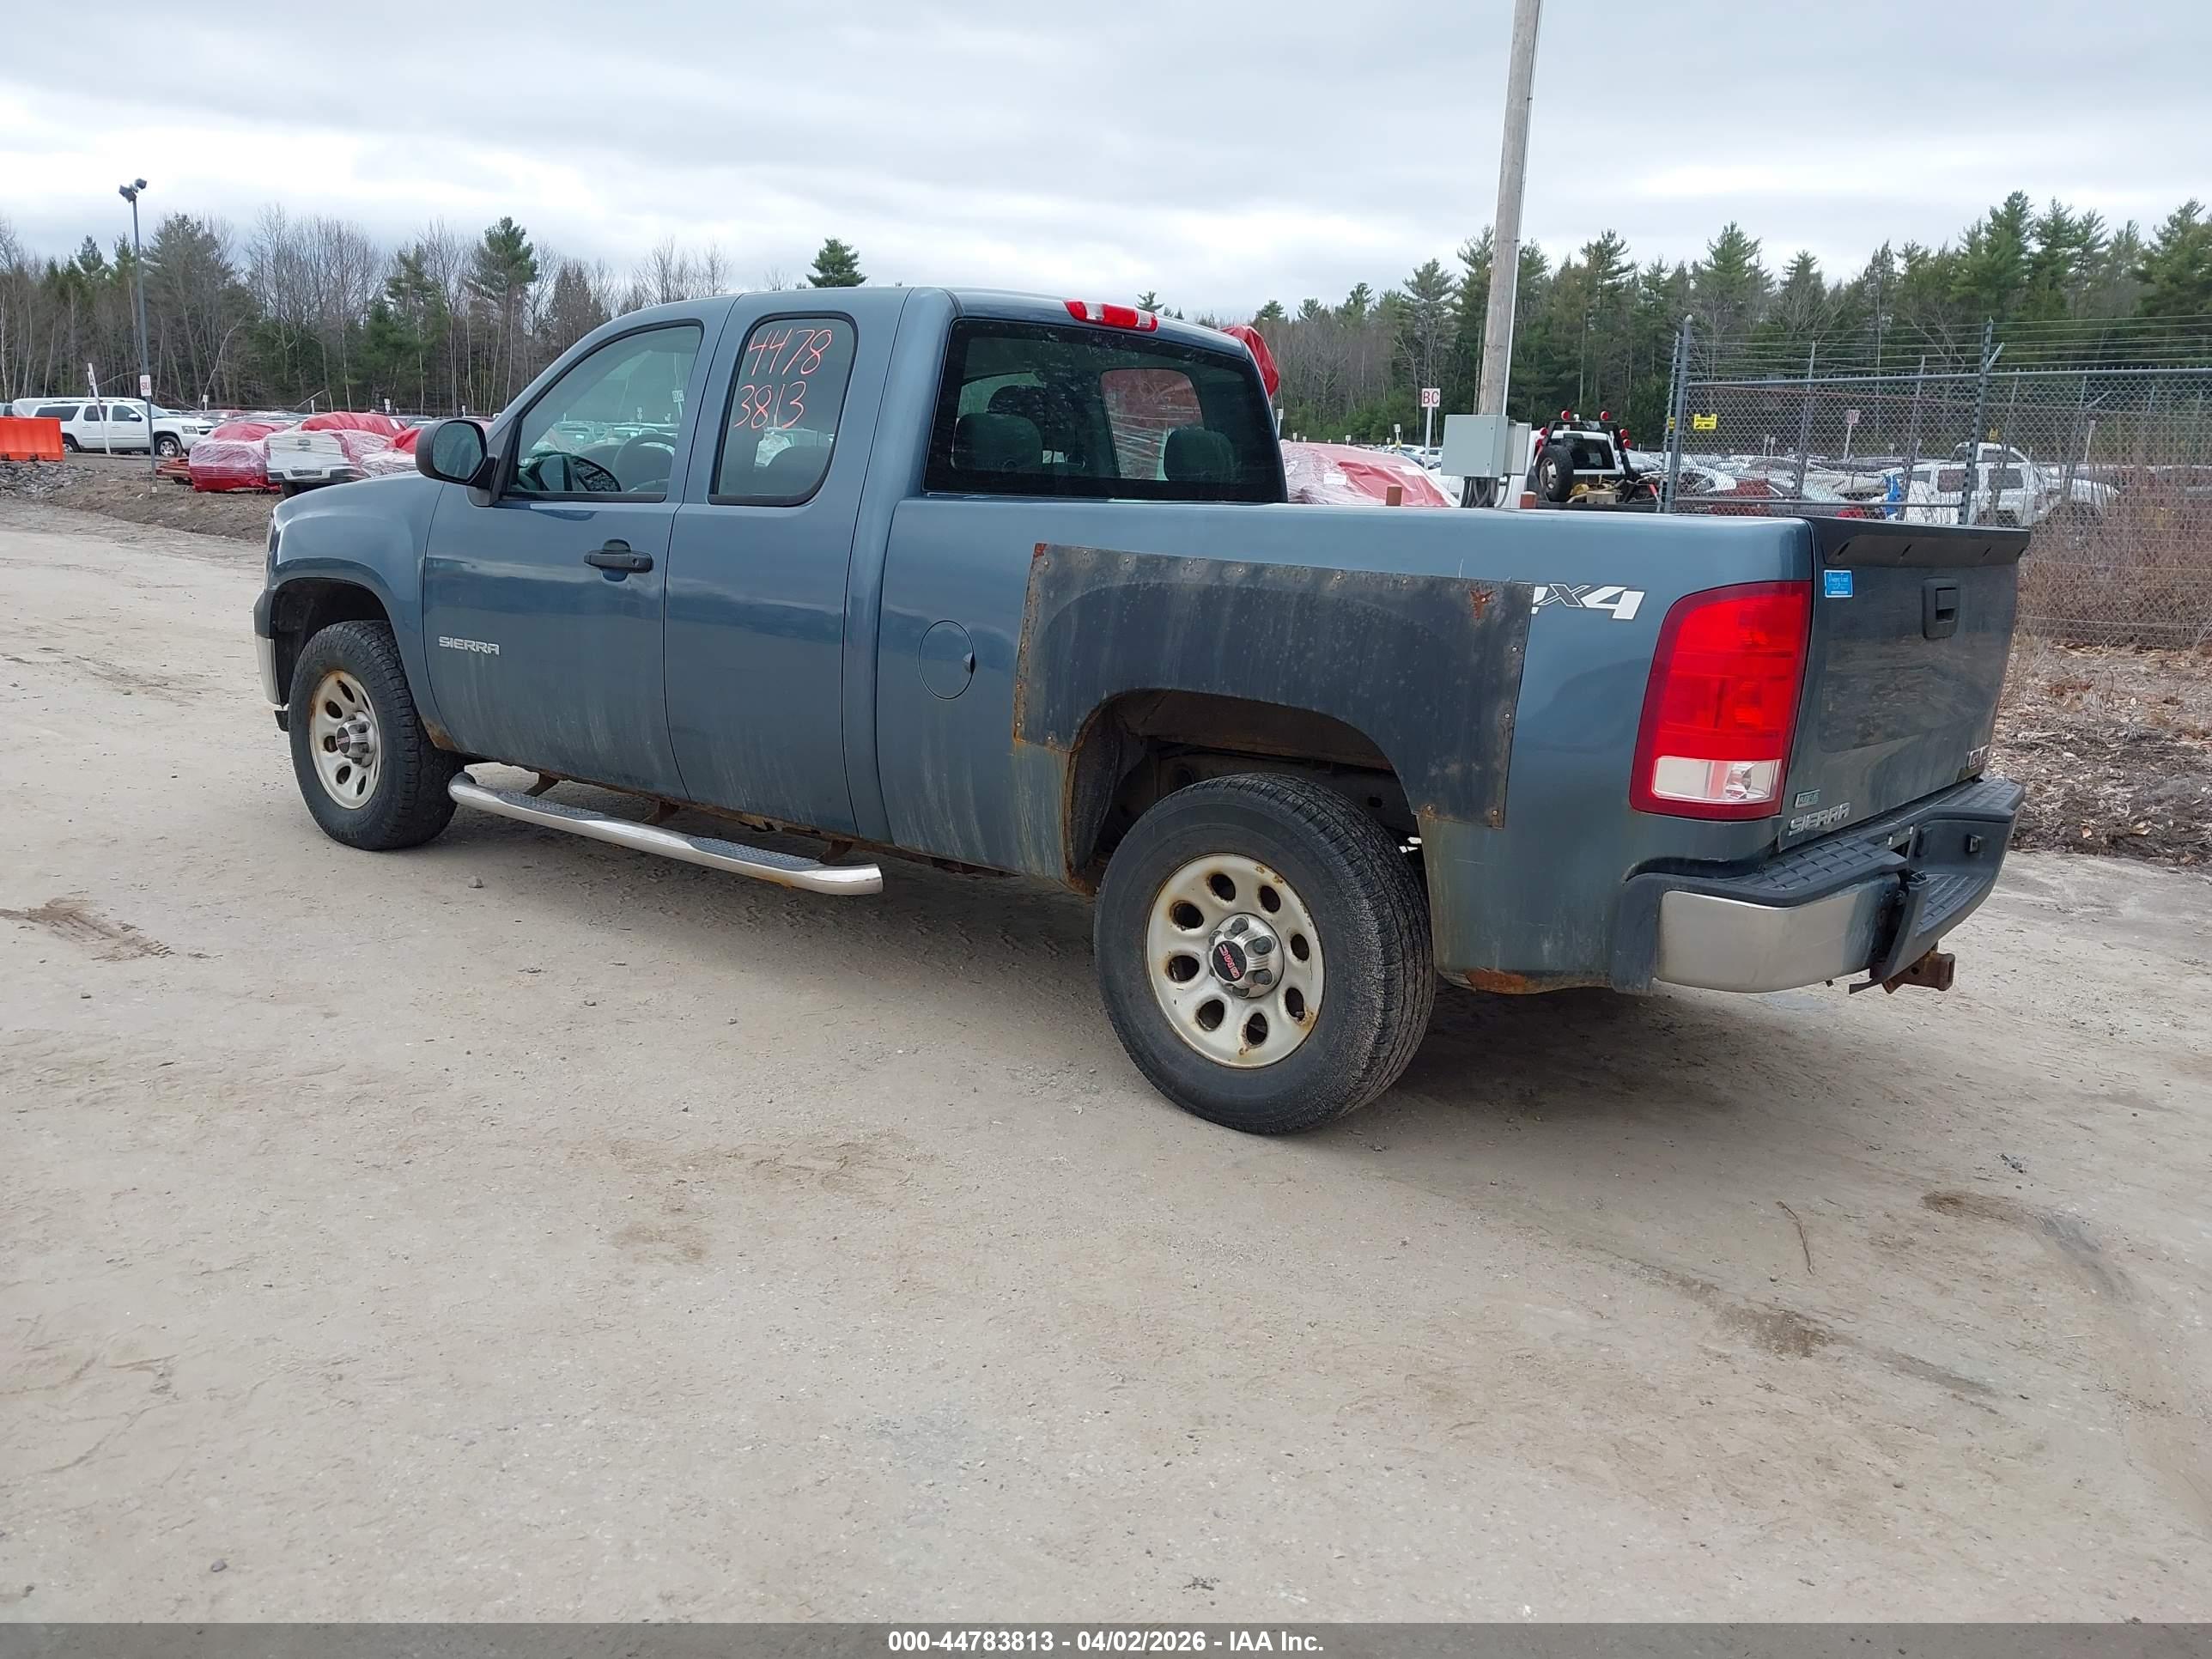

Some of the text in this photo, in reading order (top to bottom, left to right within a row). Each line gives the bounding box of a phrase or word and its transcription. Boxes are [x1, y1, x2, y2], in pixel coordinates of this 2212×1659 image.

[749, 328, 832, 376] 4478
[734, 380, 806, 428] 3813
[1423, 391, 1439, 404] BC
[439, 635, 500, 655] SIERRA
[1788, 802, 1850, 836] SIERRA
